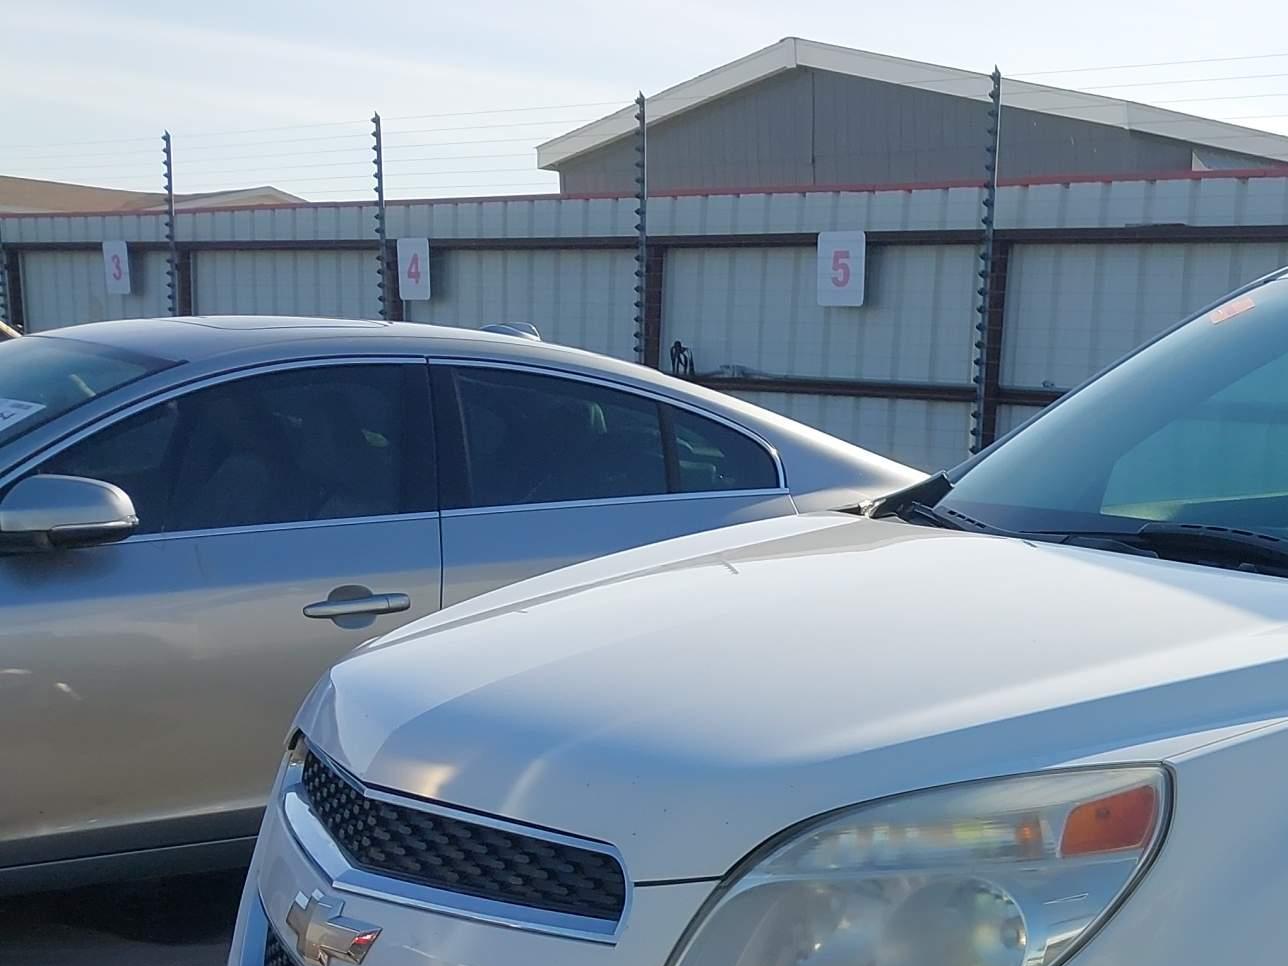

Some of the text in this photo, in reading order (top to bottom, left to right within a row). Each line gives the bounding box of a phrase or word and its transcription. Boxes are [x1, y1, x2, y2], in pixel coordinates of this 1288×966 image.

[111, 254, 123, 281] 3
[407, 253, 421, 284] 4
[831, 250, 850, 288] 5
